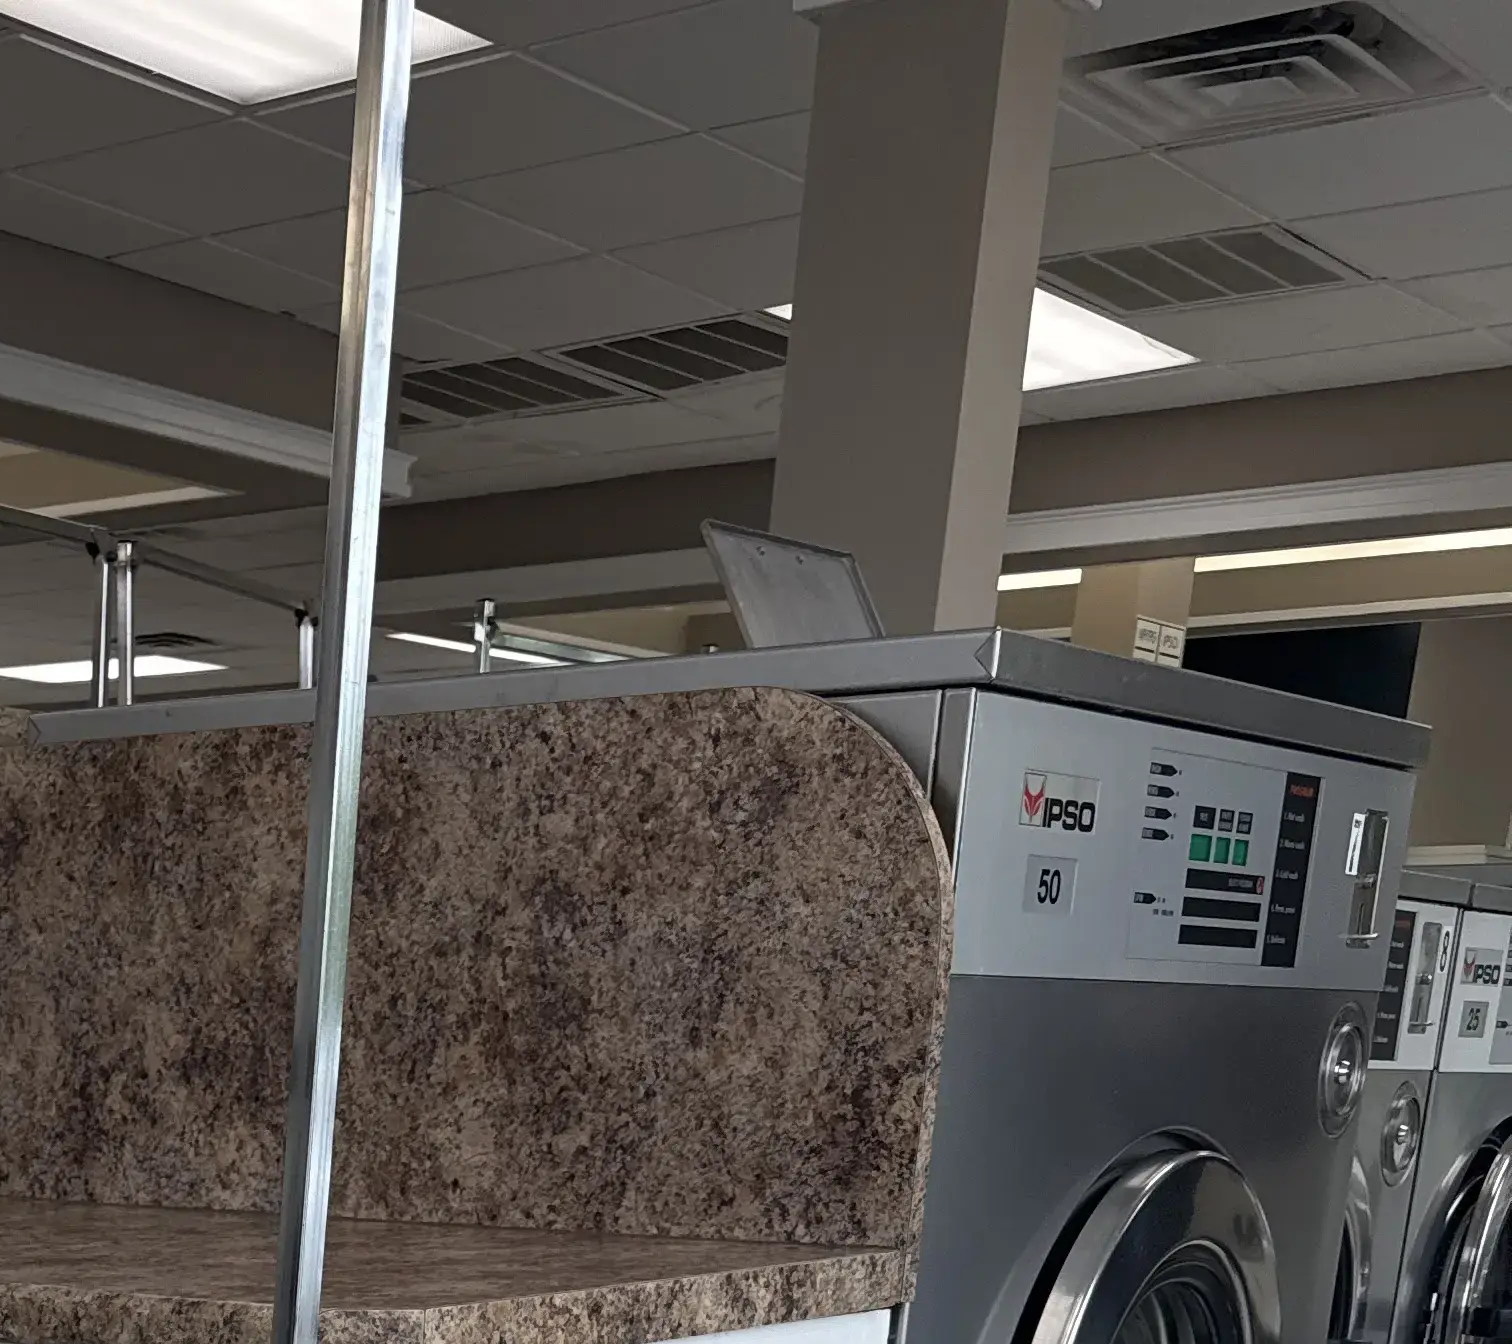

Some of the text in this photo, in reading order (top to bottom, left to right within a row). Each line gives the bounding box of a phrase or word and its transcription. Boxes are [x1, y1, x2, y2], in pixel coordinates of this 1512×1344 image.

[1042, 797, 1096, 833] IPSO
[1036, 868, 1062, 905] 50
[1474, 963, 1501, 985] IPSO
[1467, 1008, 1481, 1031] 25
